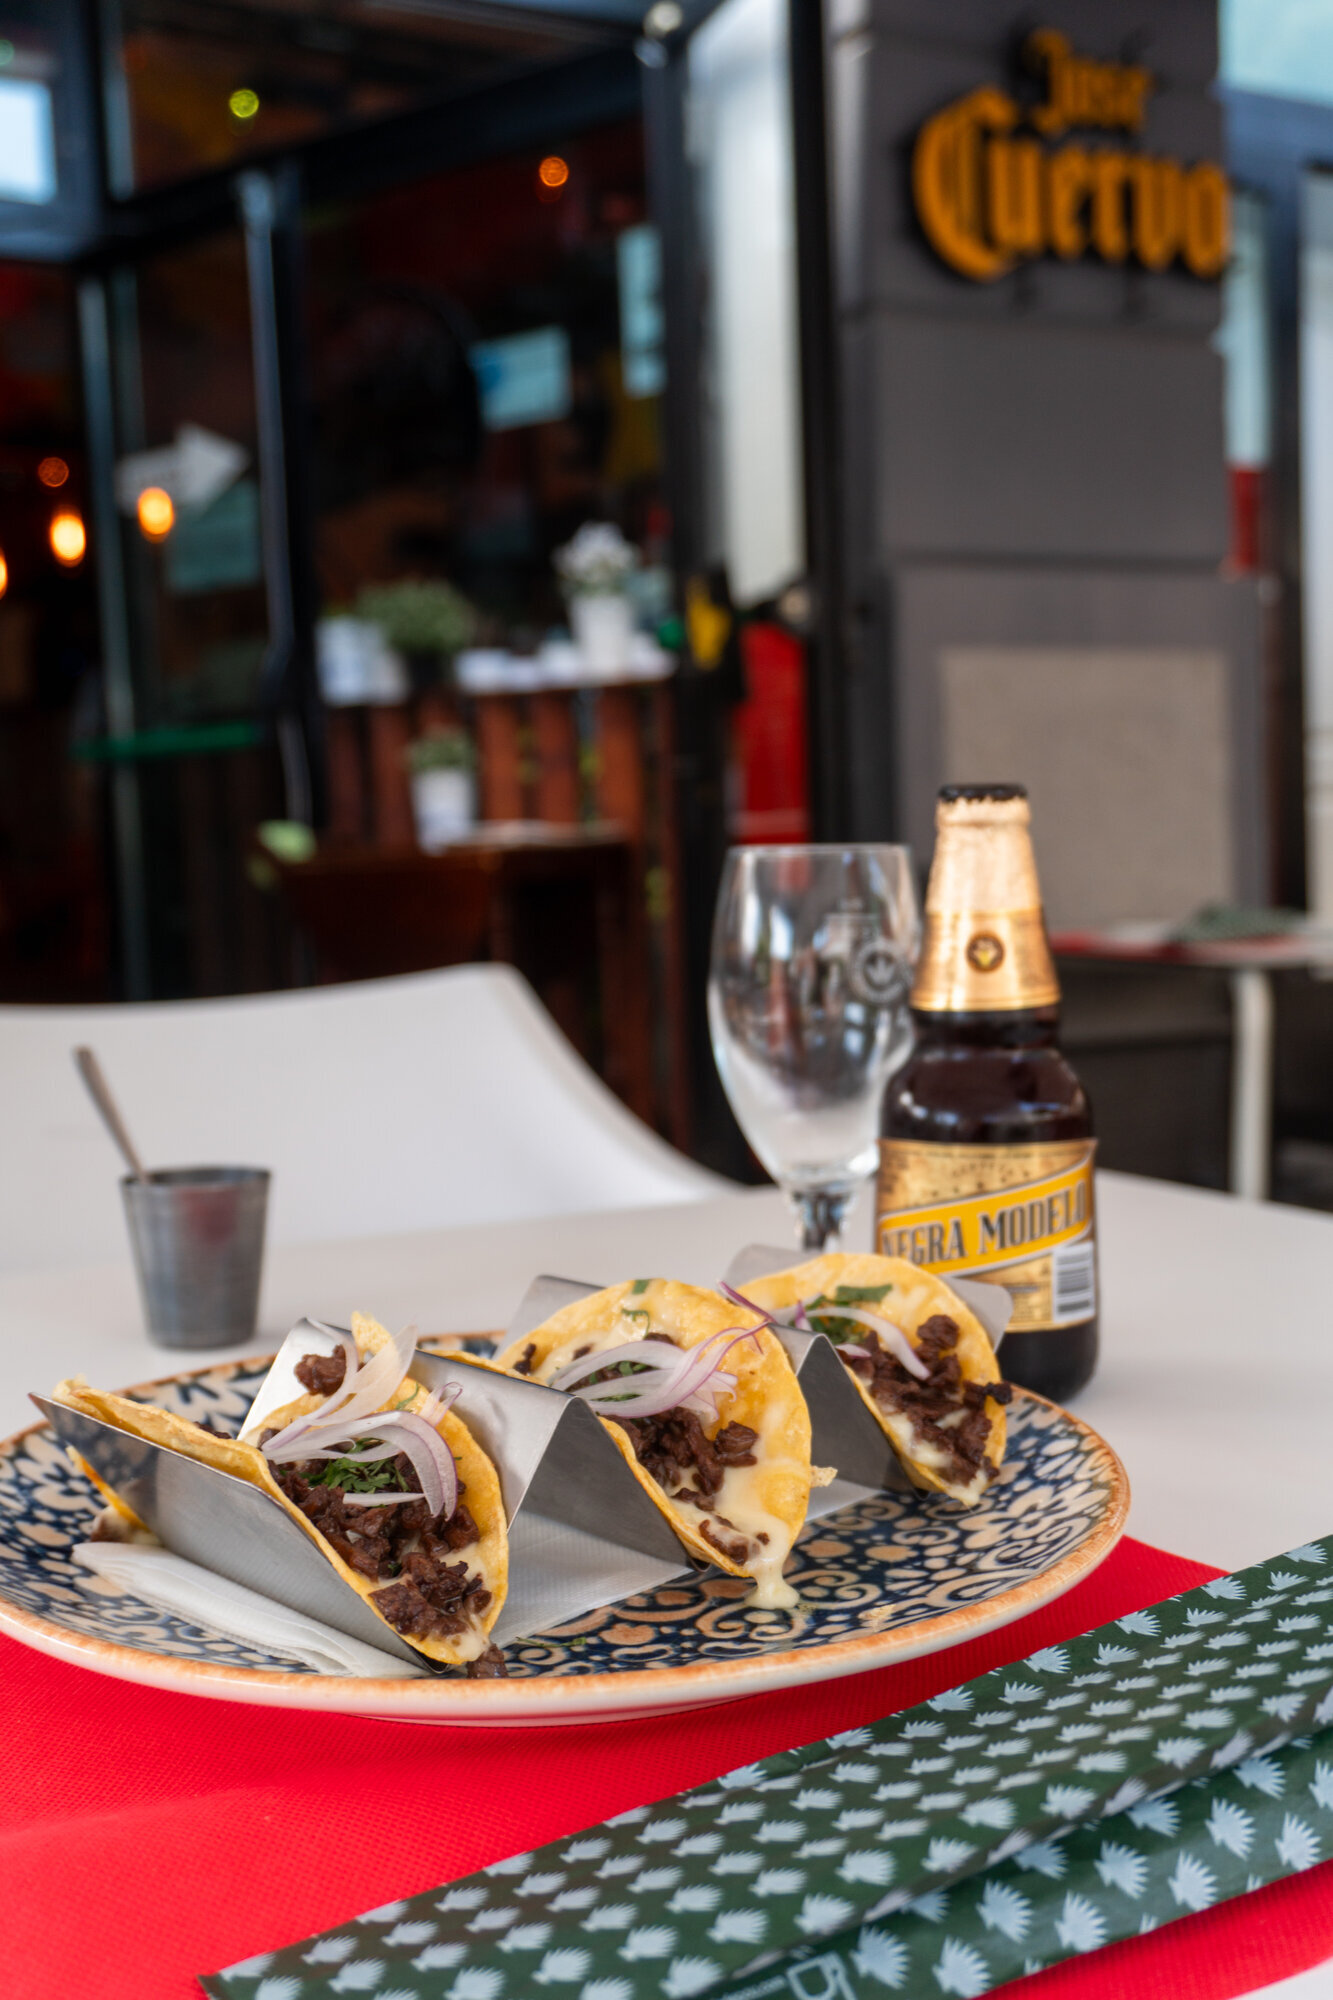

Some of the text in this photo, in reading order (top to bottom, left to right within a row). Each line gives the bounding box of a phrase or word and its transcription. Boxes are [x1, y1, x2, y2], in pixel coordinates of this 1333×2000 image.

[911, 84, 1229, 280] Cuervo
[881, 1178, 1087, 1266] NEGRA MODELO
